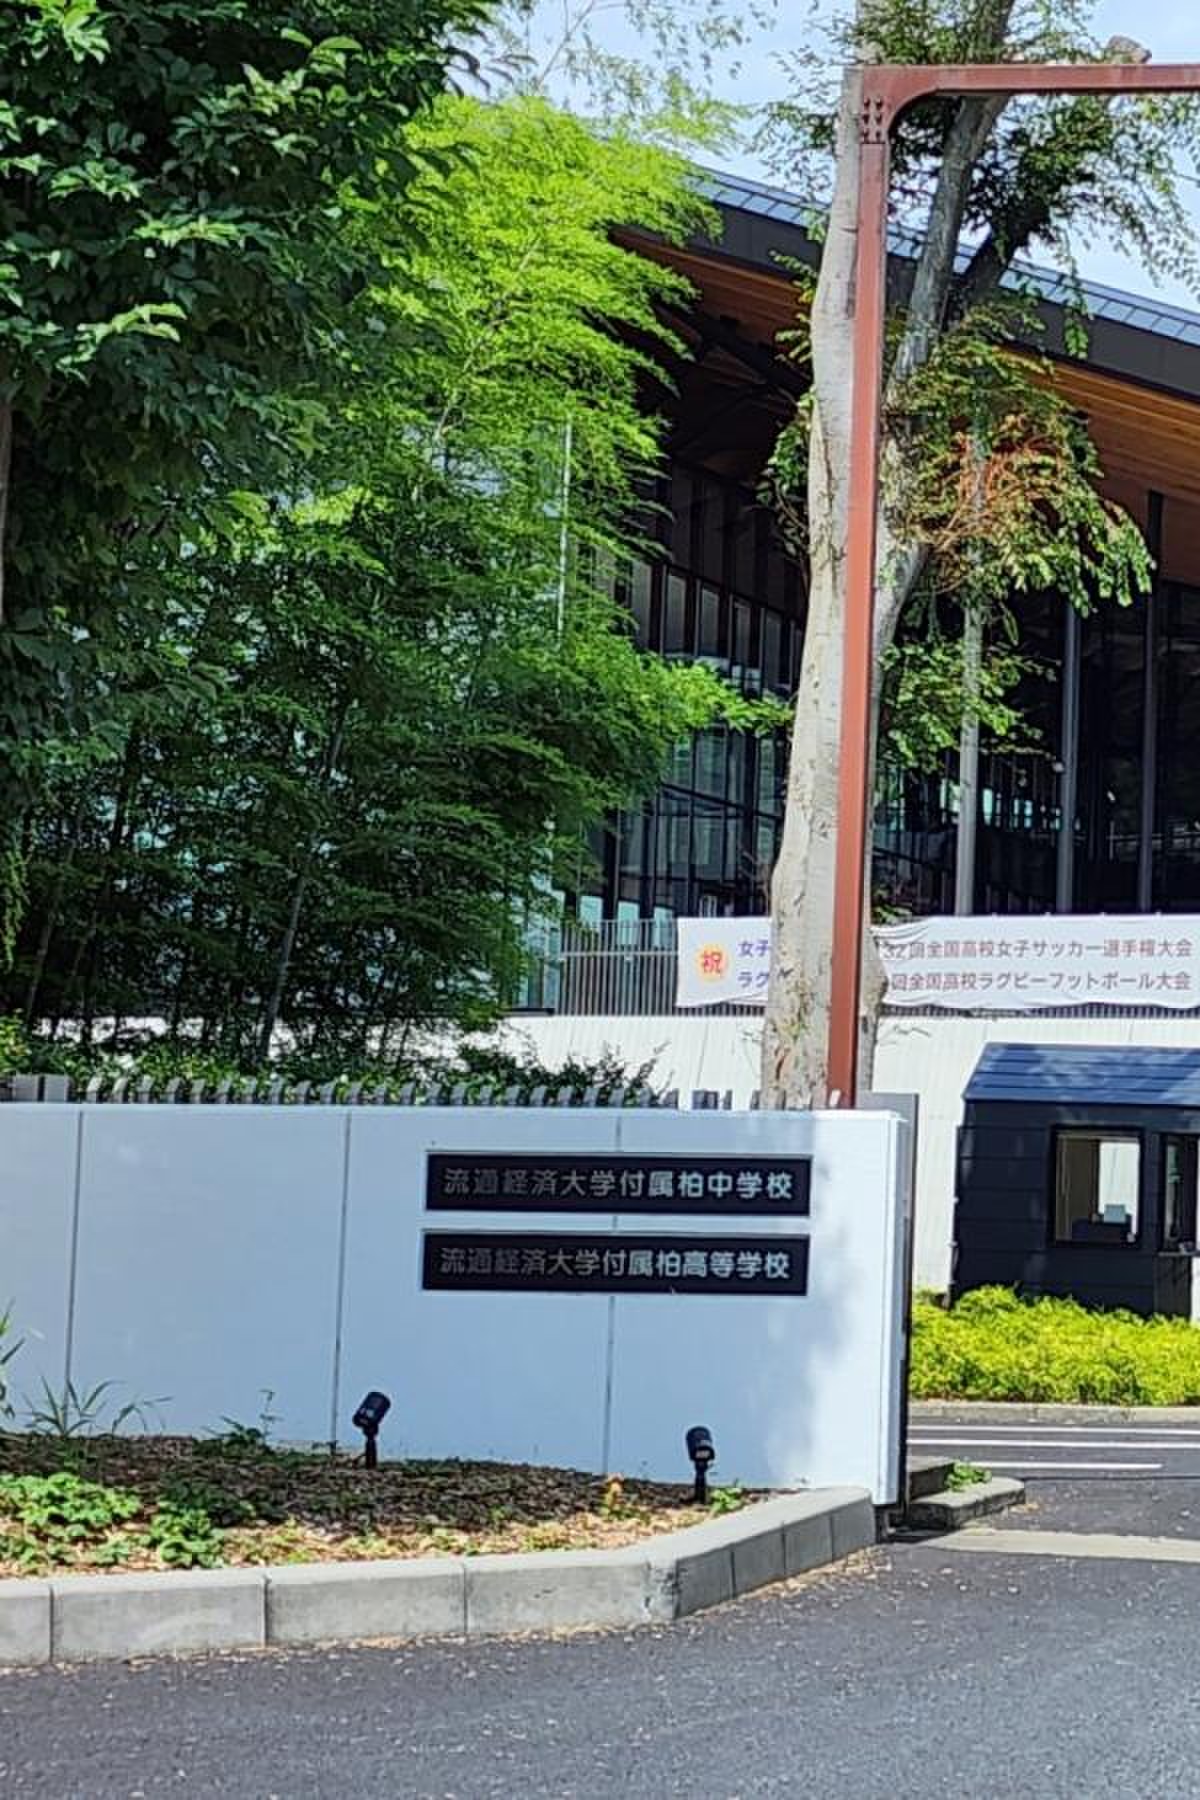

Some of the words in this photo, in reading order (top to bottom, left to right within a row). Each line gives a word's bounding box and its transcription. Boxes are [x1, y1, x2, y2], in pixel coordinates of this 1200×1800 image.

[700, 951, 722, 974] 祝
[443, 1168, 793, 1199] 流通経済大学付属柏中学校
[440, 1248, 790, 1279] 流通経済大学付属柏高等学校
